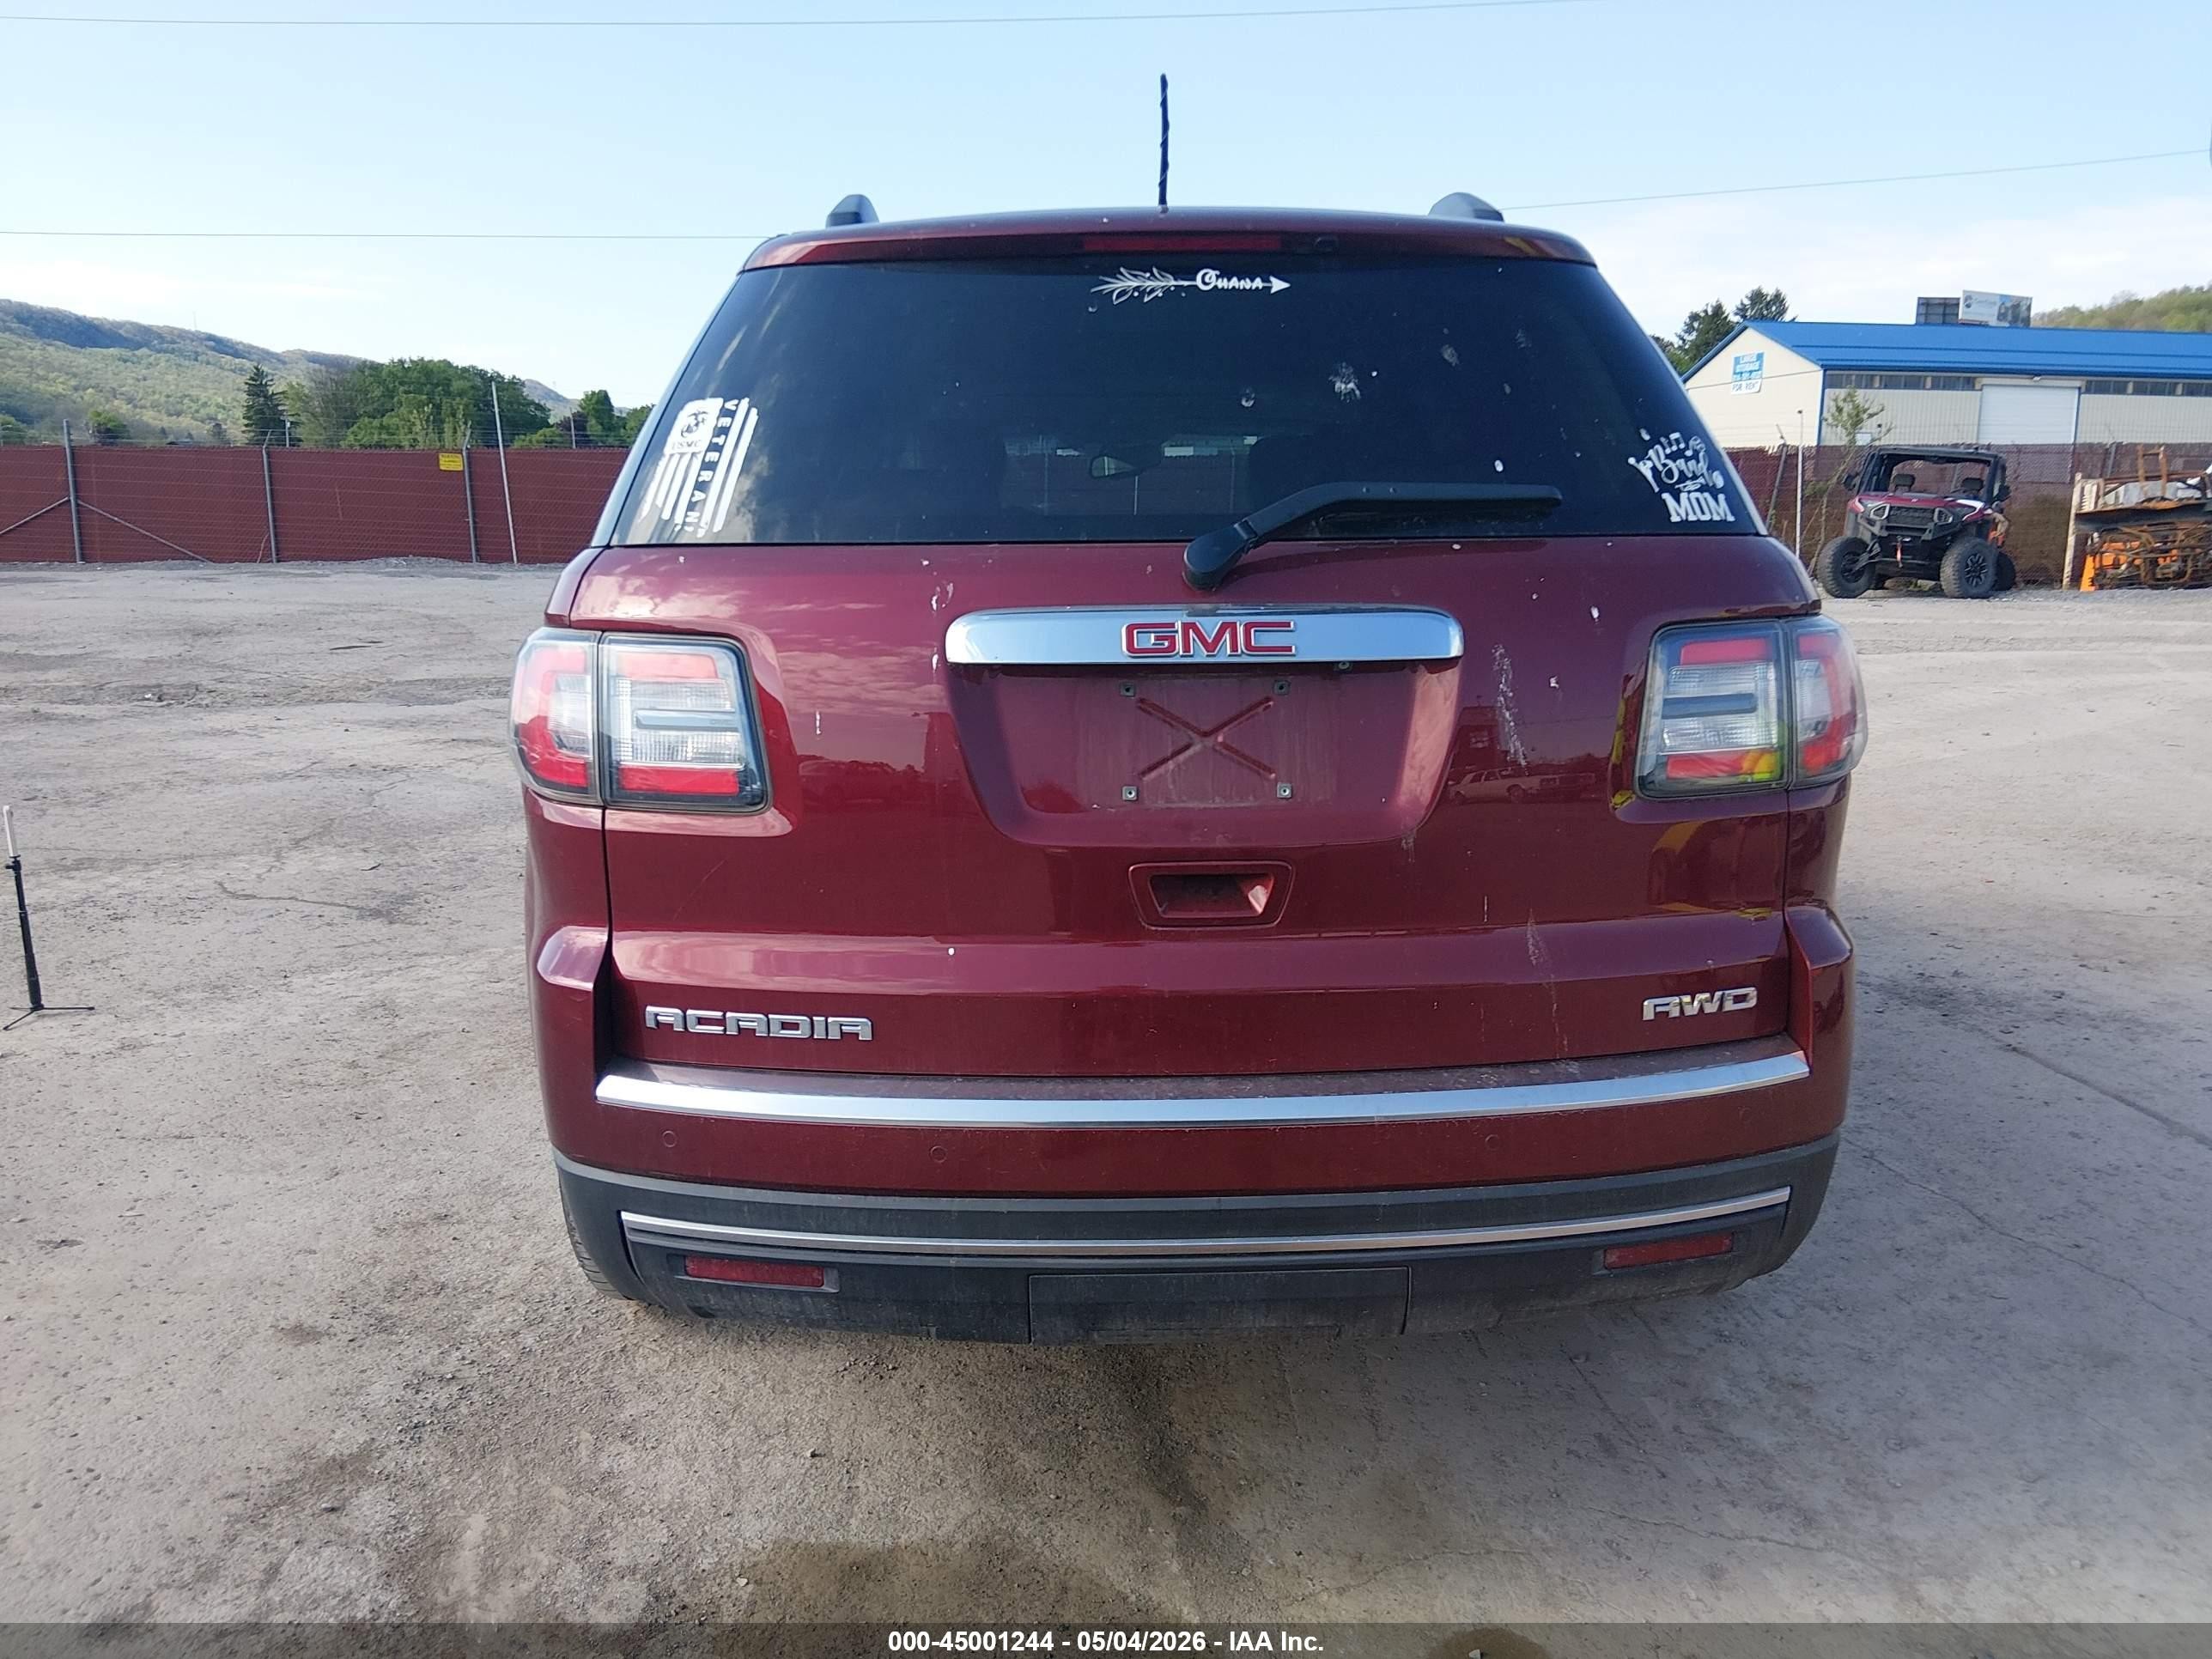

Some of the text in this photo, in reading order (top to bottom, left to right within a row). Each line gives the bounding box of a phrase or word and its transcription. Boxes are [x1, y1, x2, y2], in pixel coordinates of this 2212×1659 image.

[684, 398, 739, 523] VETERAN
[1661, 491, 1736, 523] MOM
[1121, 620, 1296, 658] GMC
[1642, 987, 1758, 1021] AWD
[644, 1005, 873, 1042] ACADIA
